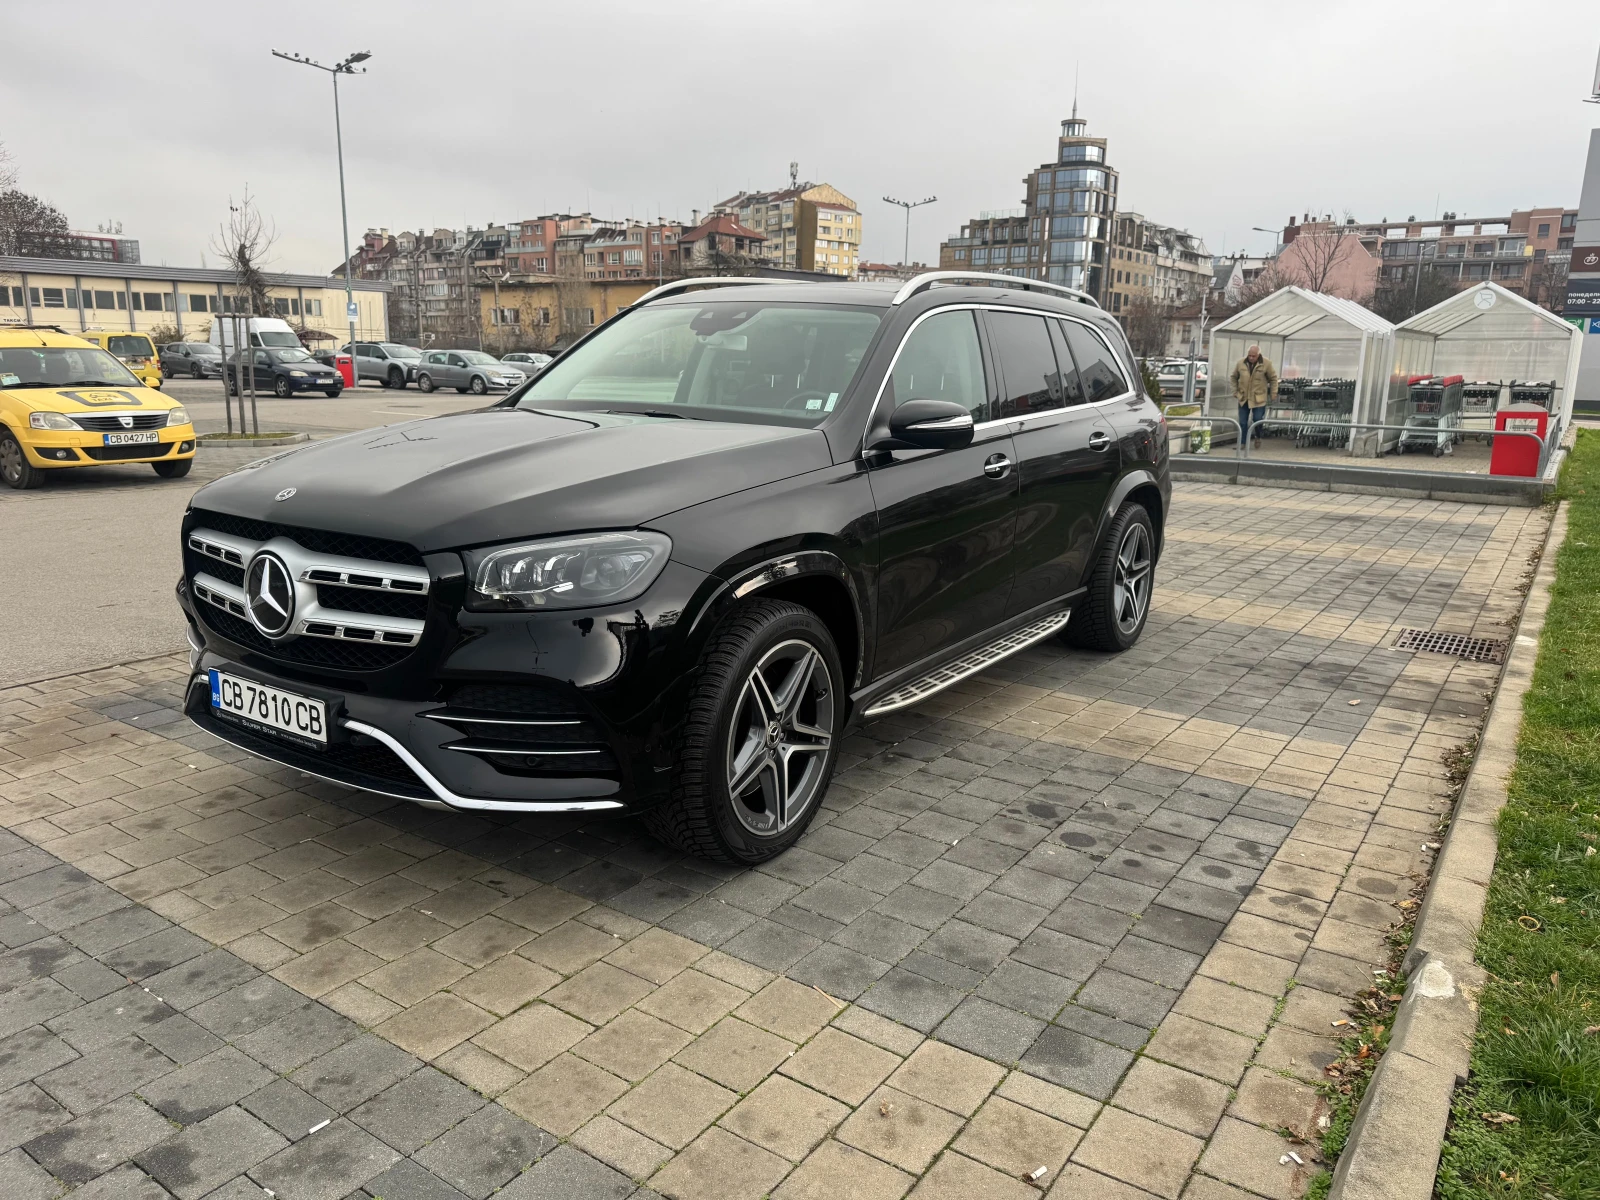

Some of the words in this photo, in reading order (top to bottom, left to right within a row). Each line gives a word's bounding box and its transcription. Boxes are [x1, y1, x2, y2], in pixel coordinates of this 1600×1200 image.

[110, 435, 123, 444] CB
[123, 434, 145, 443] 0427
[146, 433, 157, 442] HP
[222, 679, 244, 711] CB
[246, 686, 291, 726] 7810
[295, 701, 322, 735] CB
